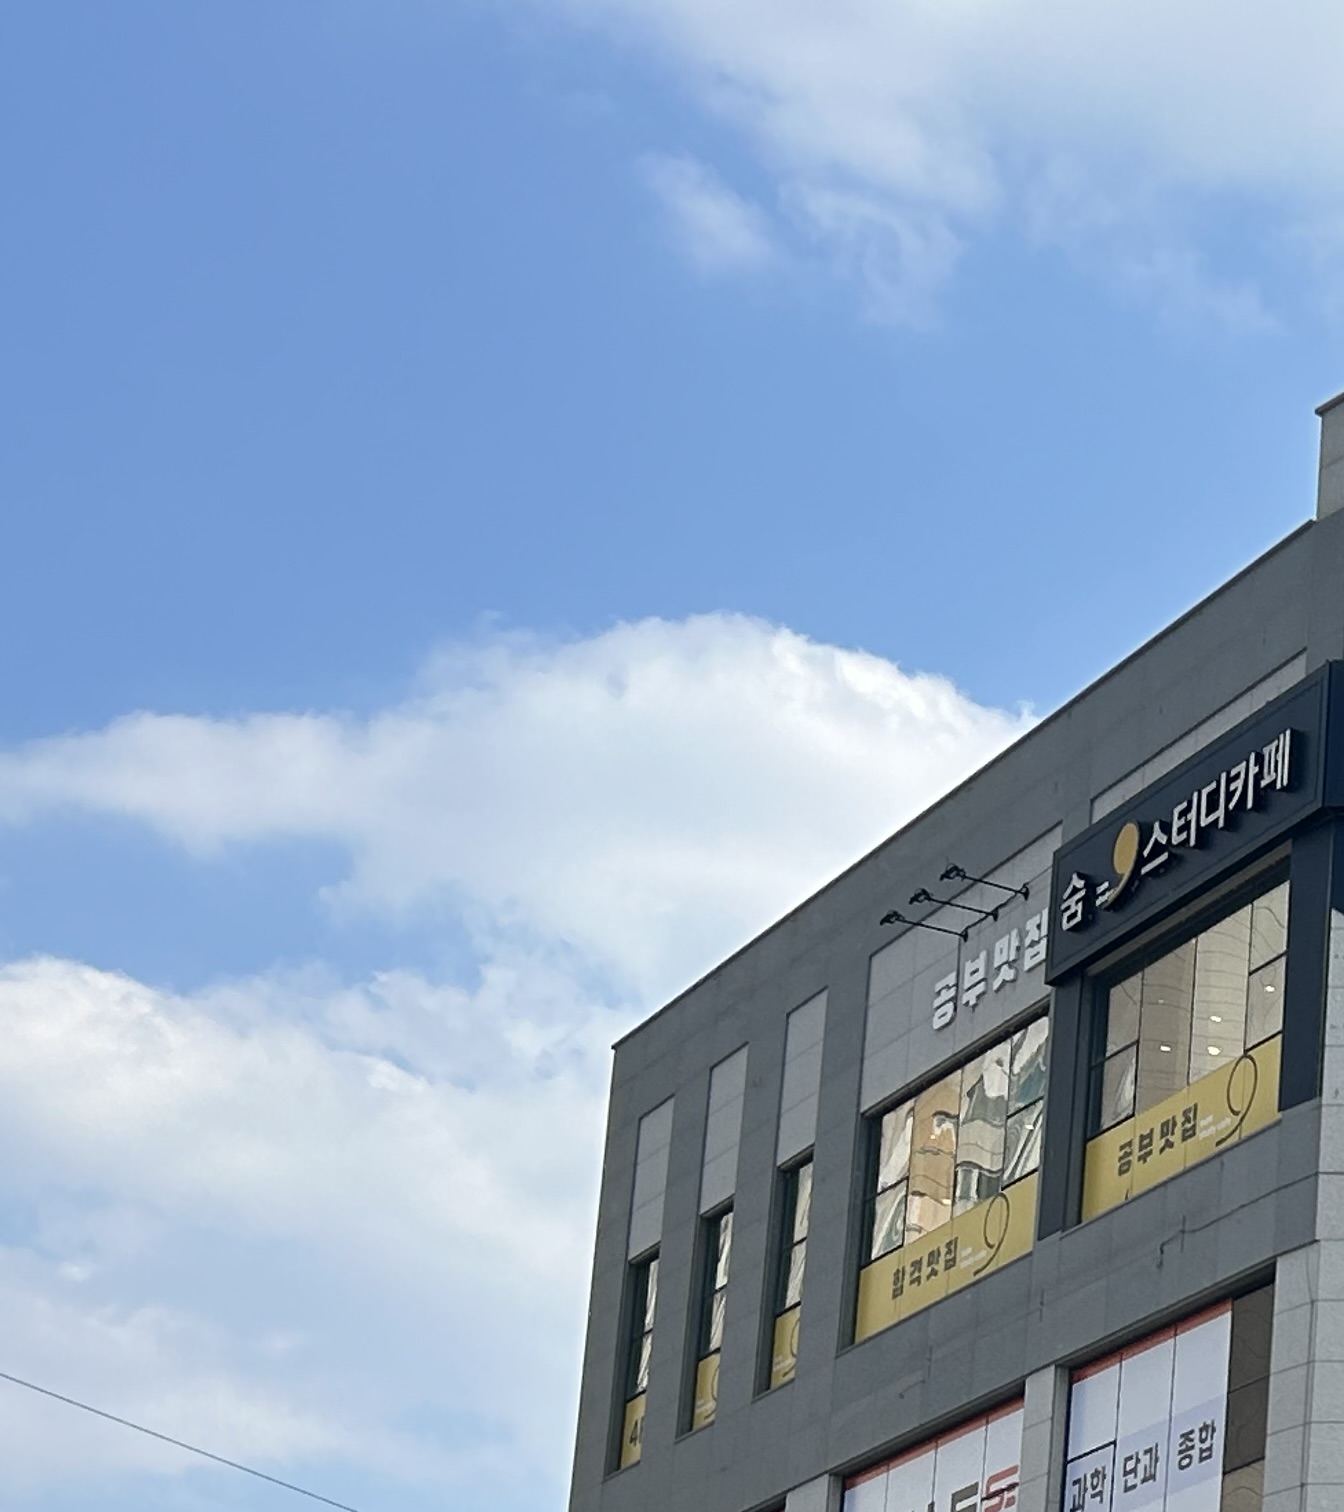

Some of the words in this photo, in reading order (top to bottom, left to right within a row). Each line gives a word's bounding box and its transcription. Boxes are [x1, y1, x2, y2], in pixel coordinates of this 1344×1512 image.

[1061, 872, 1086, 932] 숨
[1141, 728, 1293, 876] 스터디카페
[932, 907, 1048, 1031] 공부맛집
[1118, 1103, 1199, 1176] 공부맛집
[892, 1236, 958, 1300] 합격맛집
[1122, 1443, 1160, 1493] 단과
[1177, 1419, 1216, 1471] 종합
